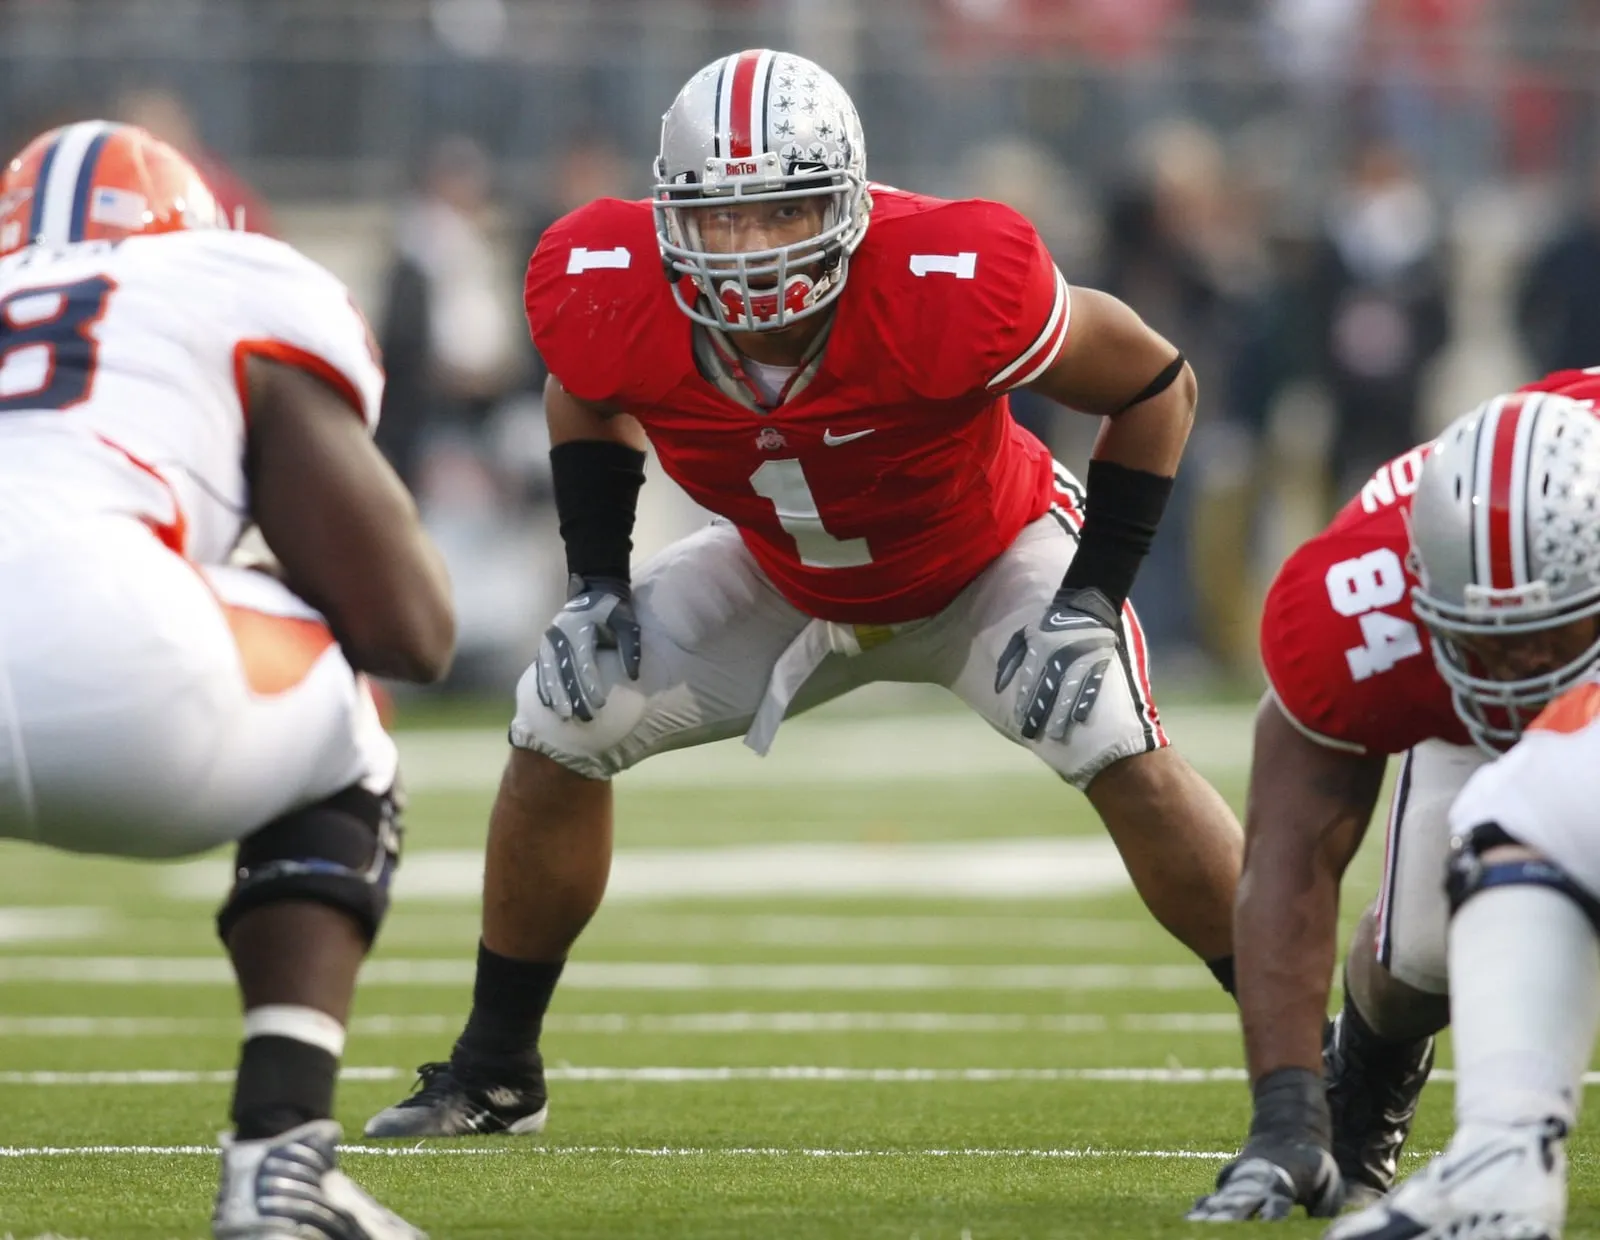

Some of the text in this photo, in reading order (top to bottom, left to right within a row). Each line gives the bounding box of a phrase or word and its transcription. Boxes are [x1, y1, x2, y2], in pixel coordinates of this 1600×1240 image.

[565, 246, 631, 275] 1
[909, 252, 977, 279] 1
[749, 458, 874, 569] 1
[1325, 547, 1422, 683] 84
